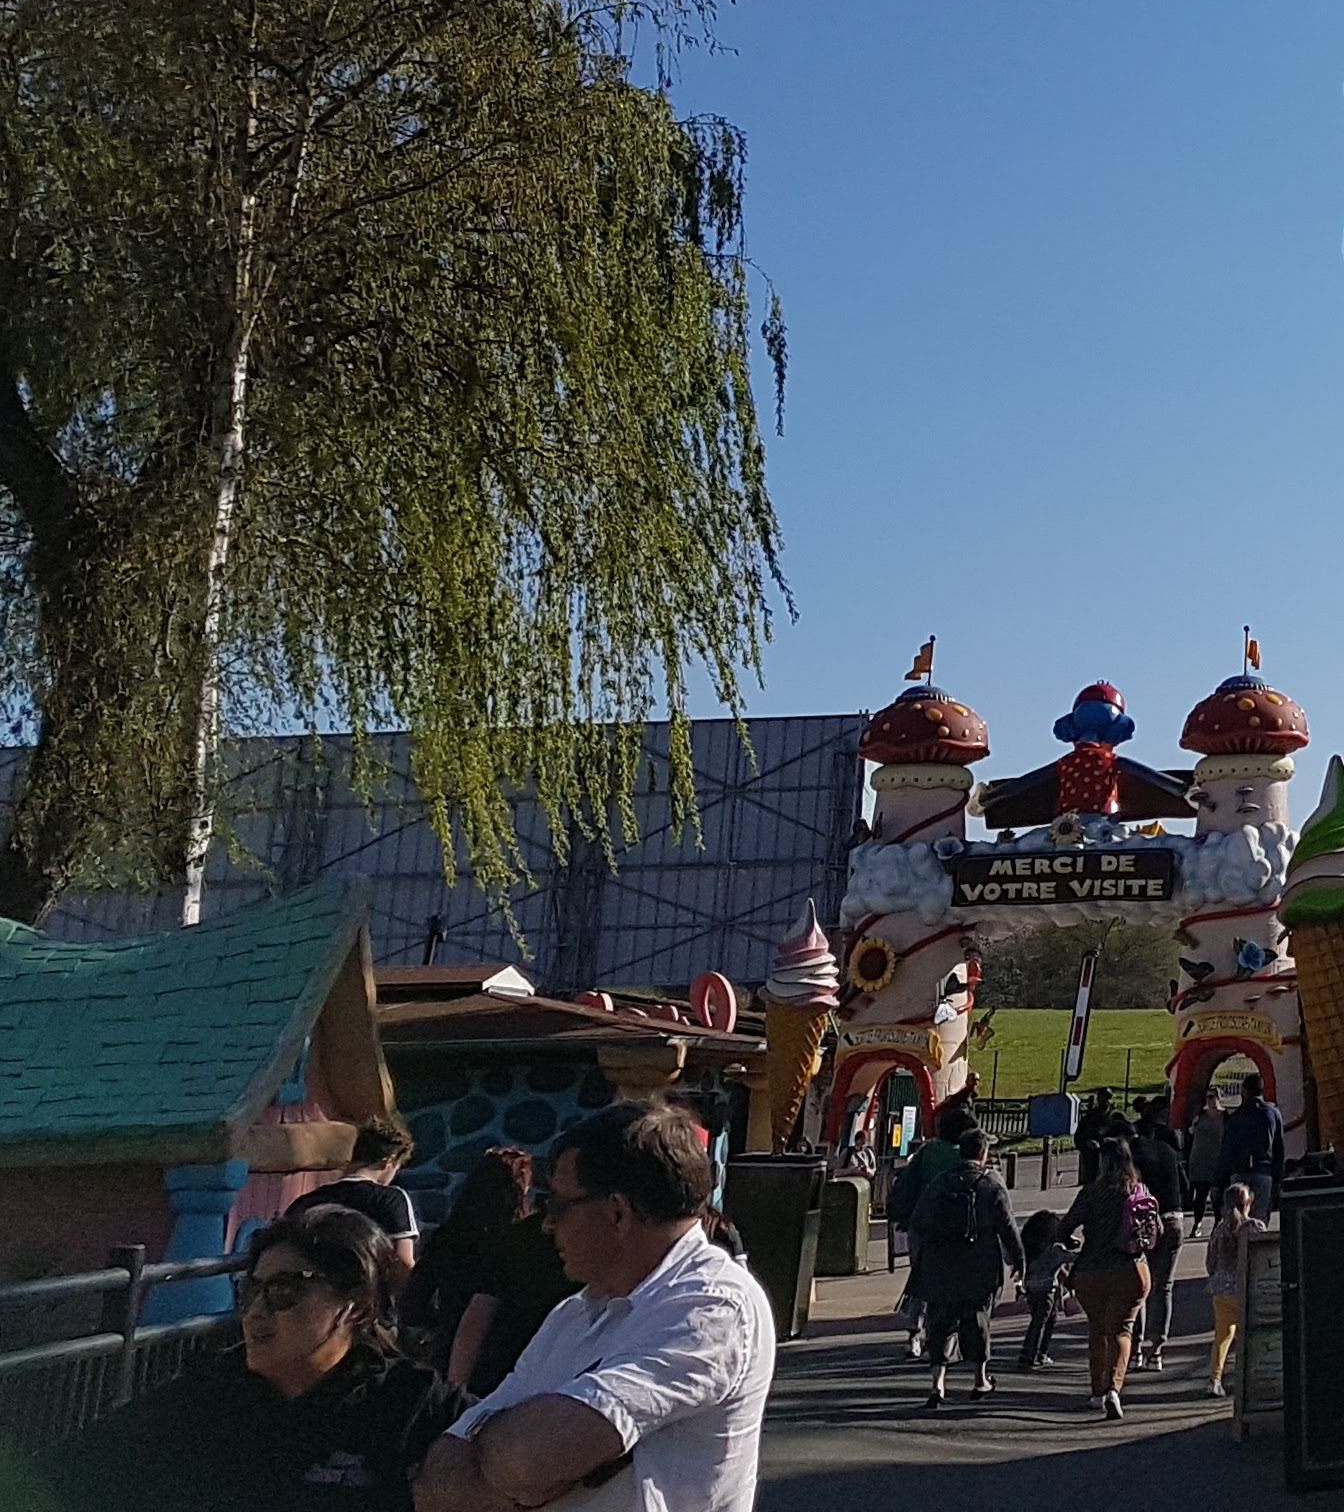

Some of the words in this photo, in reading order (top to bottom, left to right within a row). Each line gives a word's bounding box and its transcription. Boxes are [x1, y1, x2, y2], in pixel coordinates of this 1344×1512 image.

[989, 856, 1083, 876] MERCI
[1101, 855, 1135, 873] DE
[960, 882, 1056, 901] VOTRE
[1068, 879, 1163, 896] VISITE
